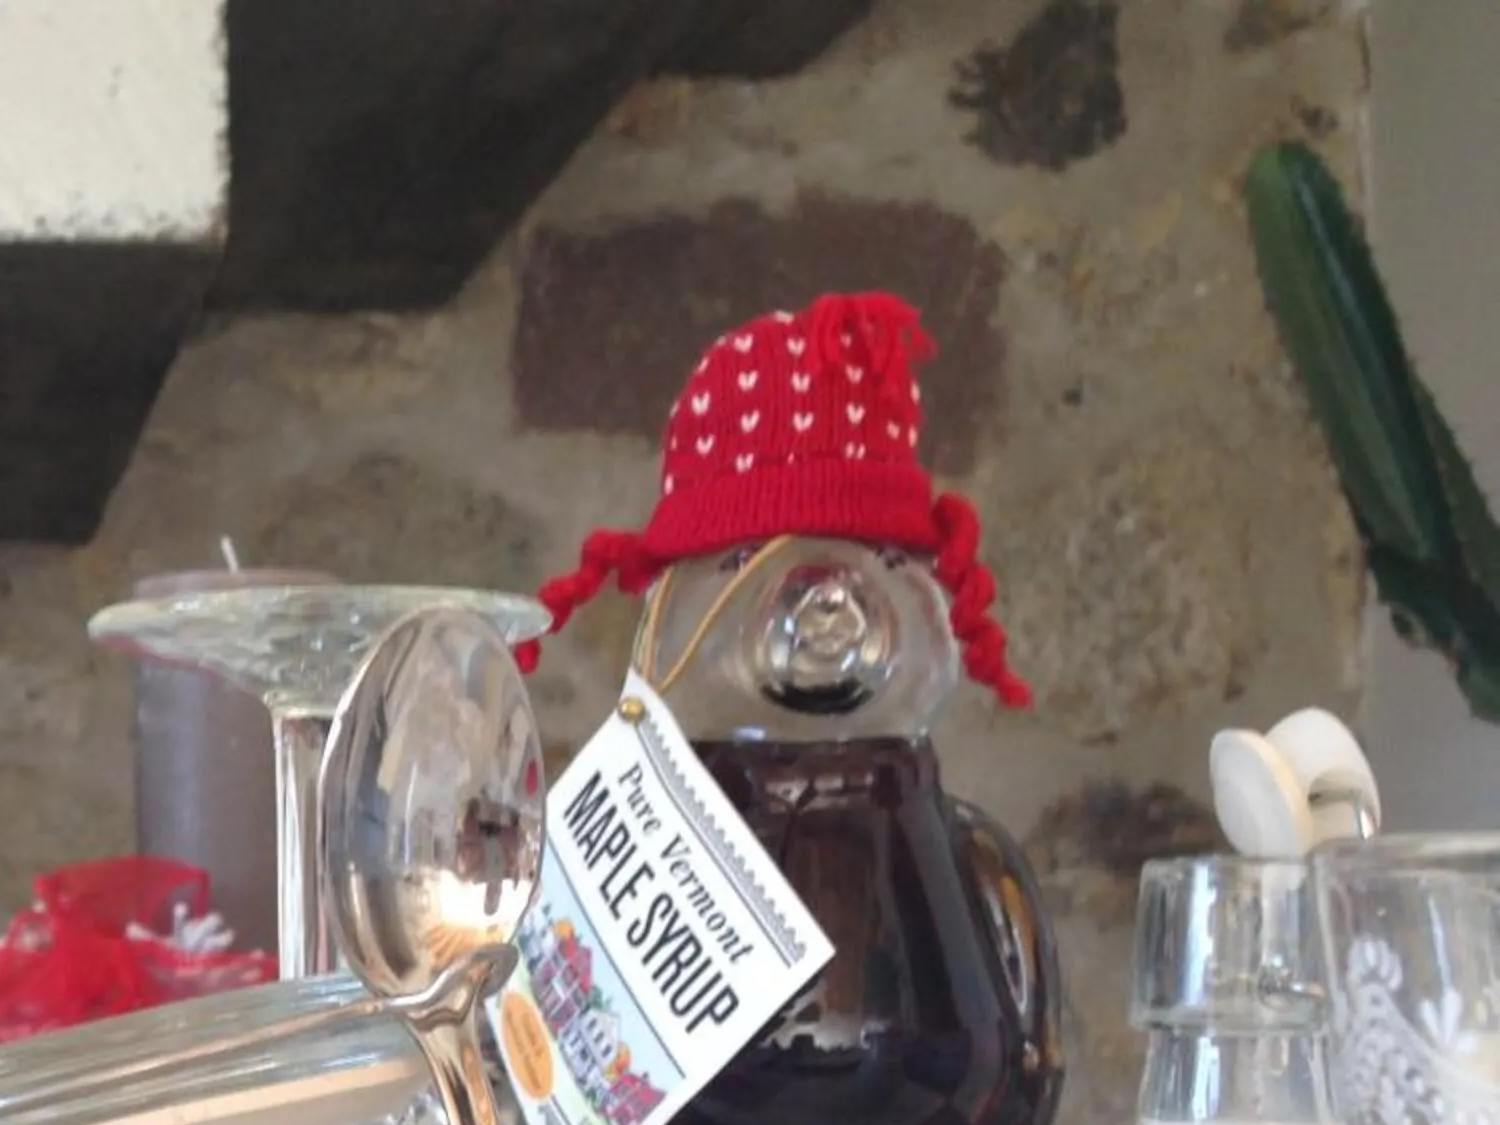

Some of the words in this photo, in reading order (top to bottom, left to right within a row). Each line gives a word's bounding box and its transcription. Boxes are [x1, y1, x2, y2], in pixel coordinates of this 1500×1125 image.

[563, 770, 655, 921] MAPLE
[626, 892, 740, 1034] SYRUP
[617, 762, 662, 835] Pure
[660, 832, 754, 964] Vermont
